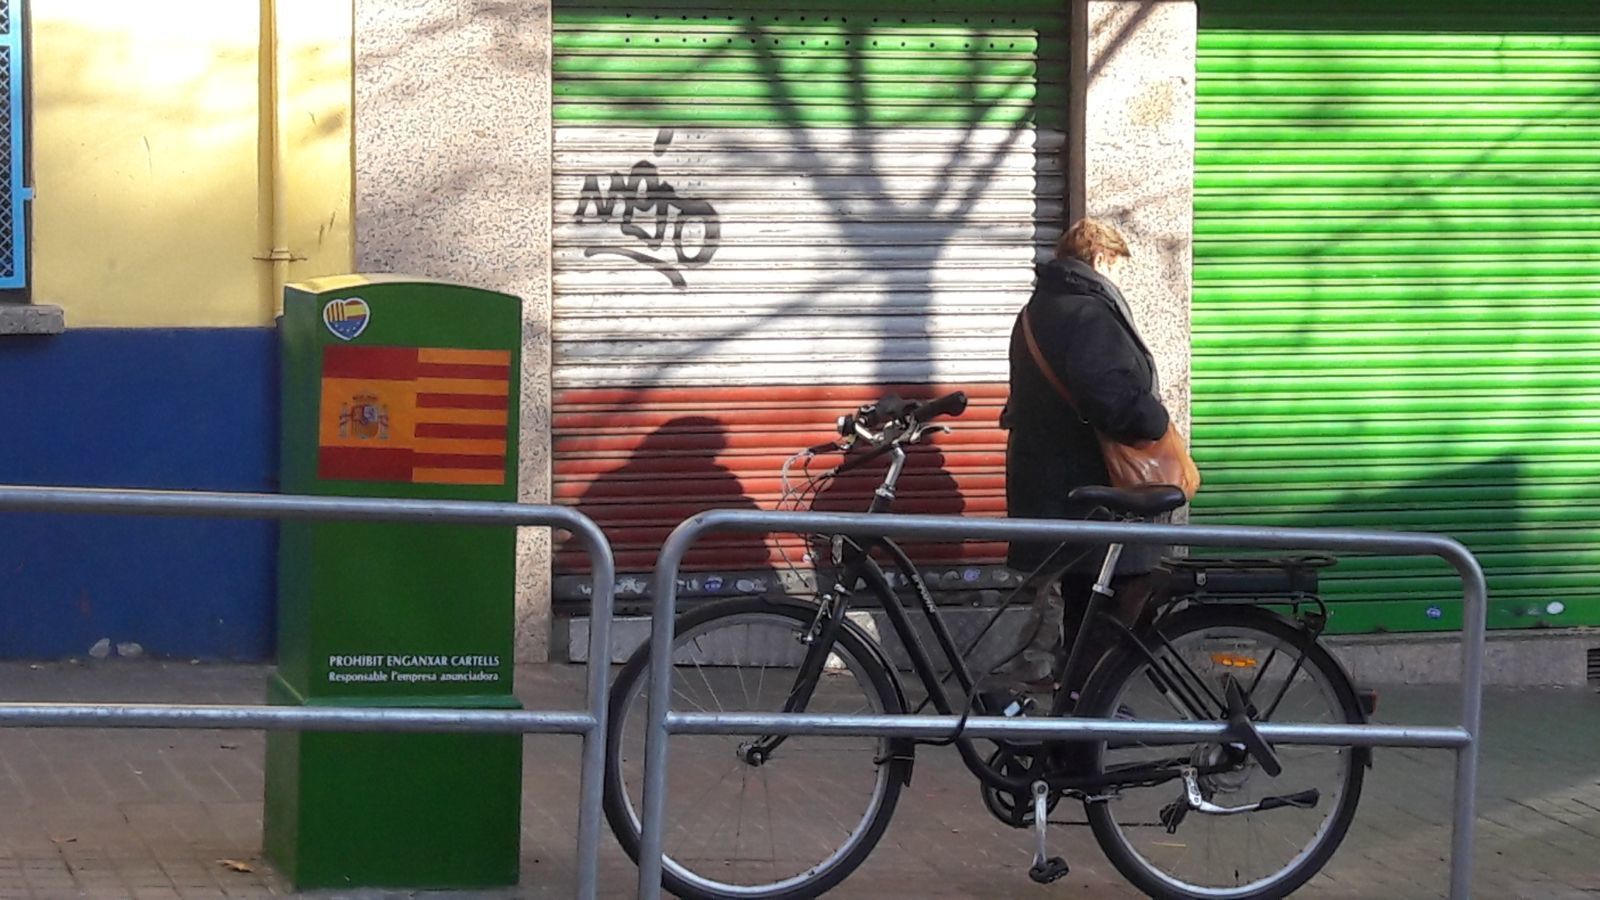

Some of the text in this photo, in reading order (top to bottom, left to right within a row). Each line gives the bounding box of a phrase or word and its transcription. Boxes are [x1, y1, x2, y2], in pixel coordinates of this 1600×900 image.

[329, 655, 500, 667] PROHIBIT ENGANXAR CARTELLS
[328, 670, 499, 683] Responsable l'empresa anunciadora
